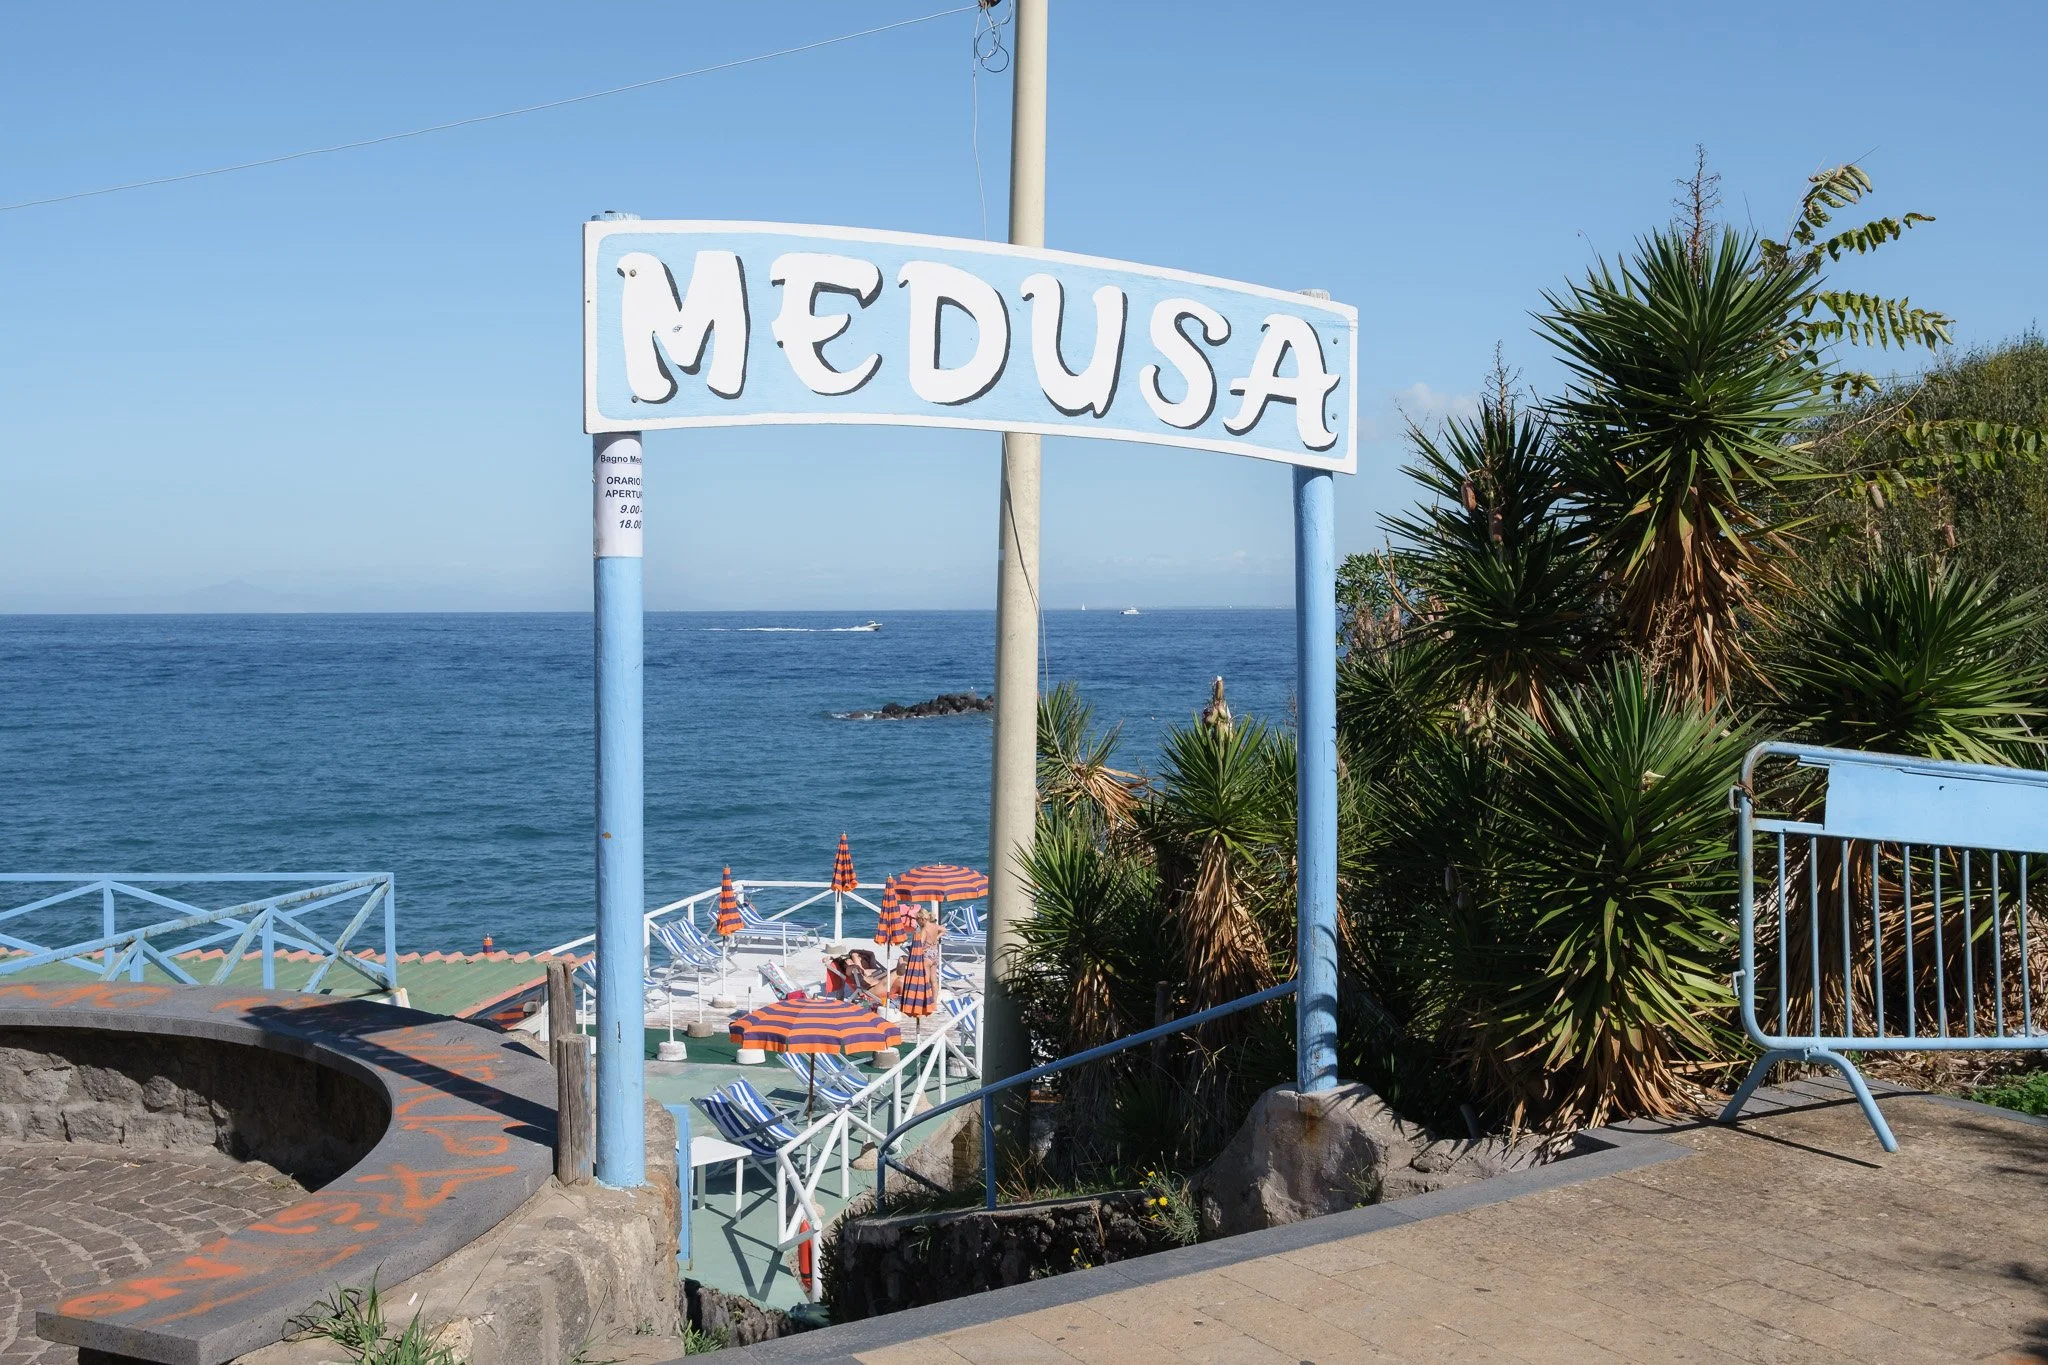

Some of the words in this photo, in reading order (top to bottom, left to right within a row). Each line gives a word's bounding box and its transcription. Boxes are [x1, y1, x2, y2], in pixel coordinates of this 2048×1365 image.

[616, 250, 1341, 450] MEDUSA
[600, 454, 628, 464] Bagno
[606, 476, 641, 486] ORARIO
[619, 519, 642, 529] 18.00
